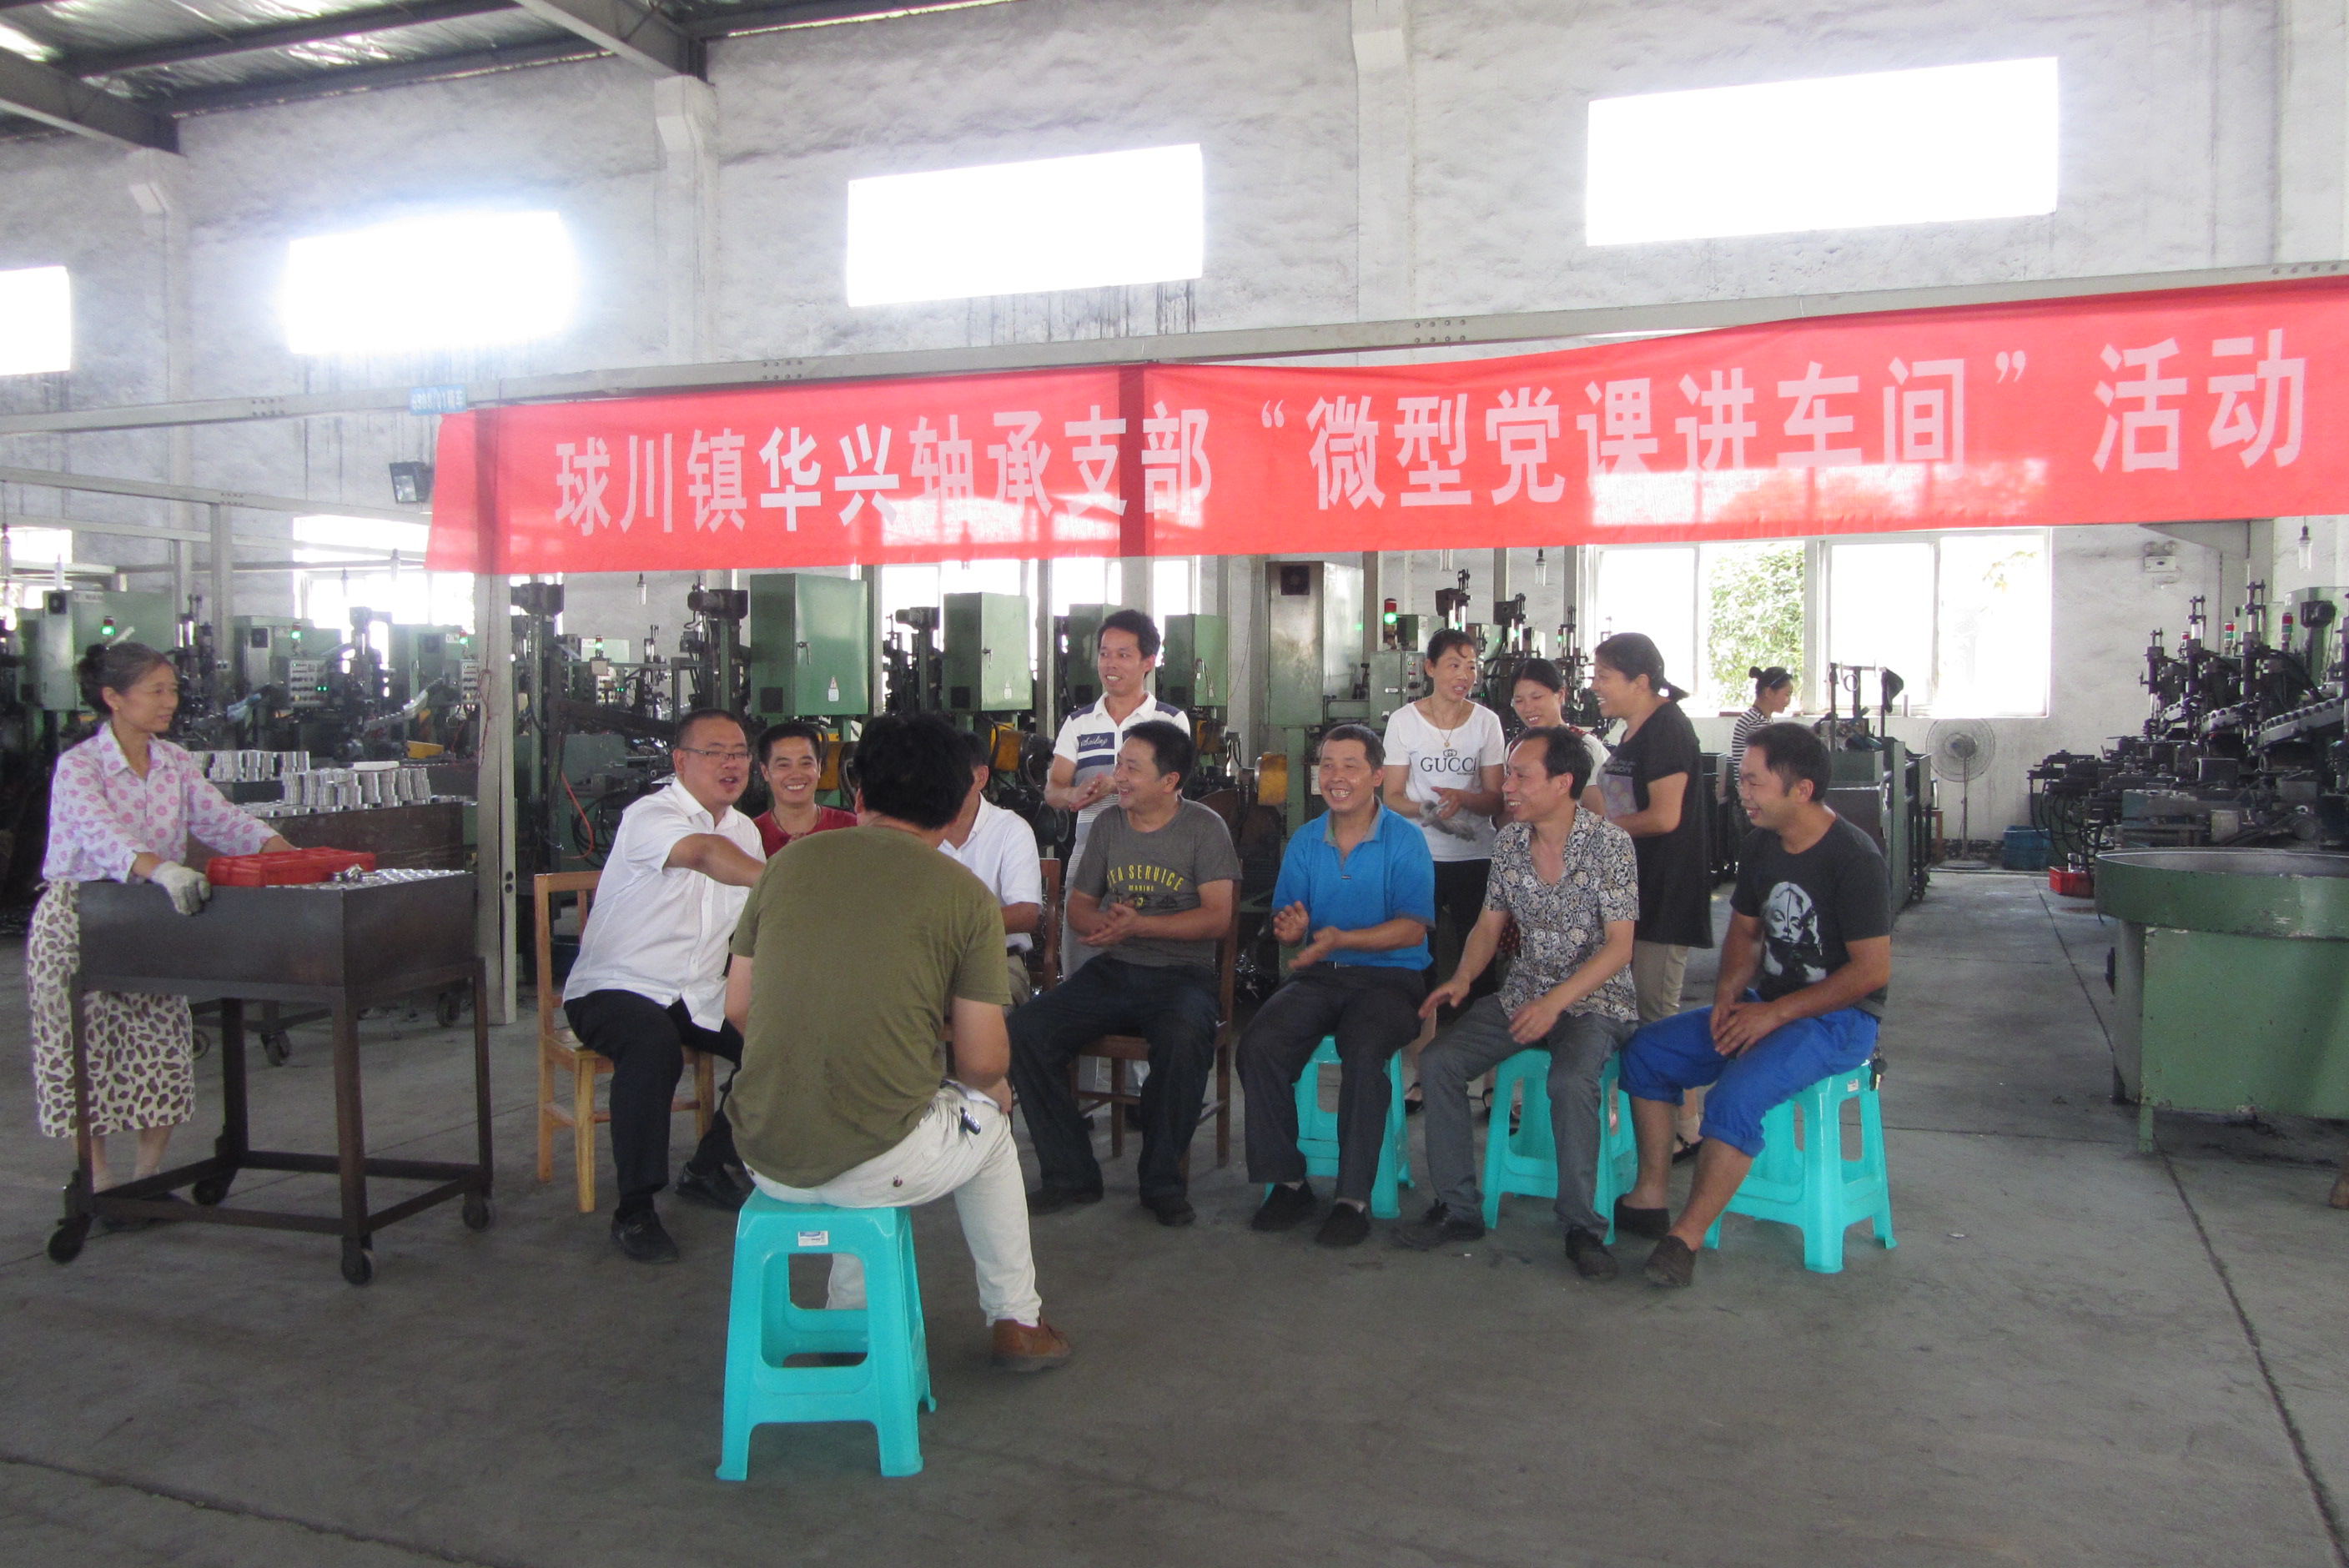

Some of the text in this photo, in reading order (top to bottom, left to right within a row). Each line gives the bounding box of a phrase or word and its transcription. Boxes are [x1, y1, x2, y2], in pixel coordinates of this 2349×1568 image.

[556, 404, 1211, 536] 球川镇华兴轴承支部
[2092, 329, 2306, 474] 活动
[1420, 756, 1476, 772] GUCCI
[1129, 865, 1185, 892] SERVICE
